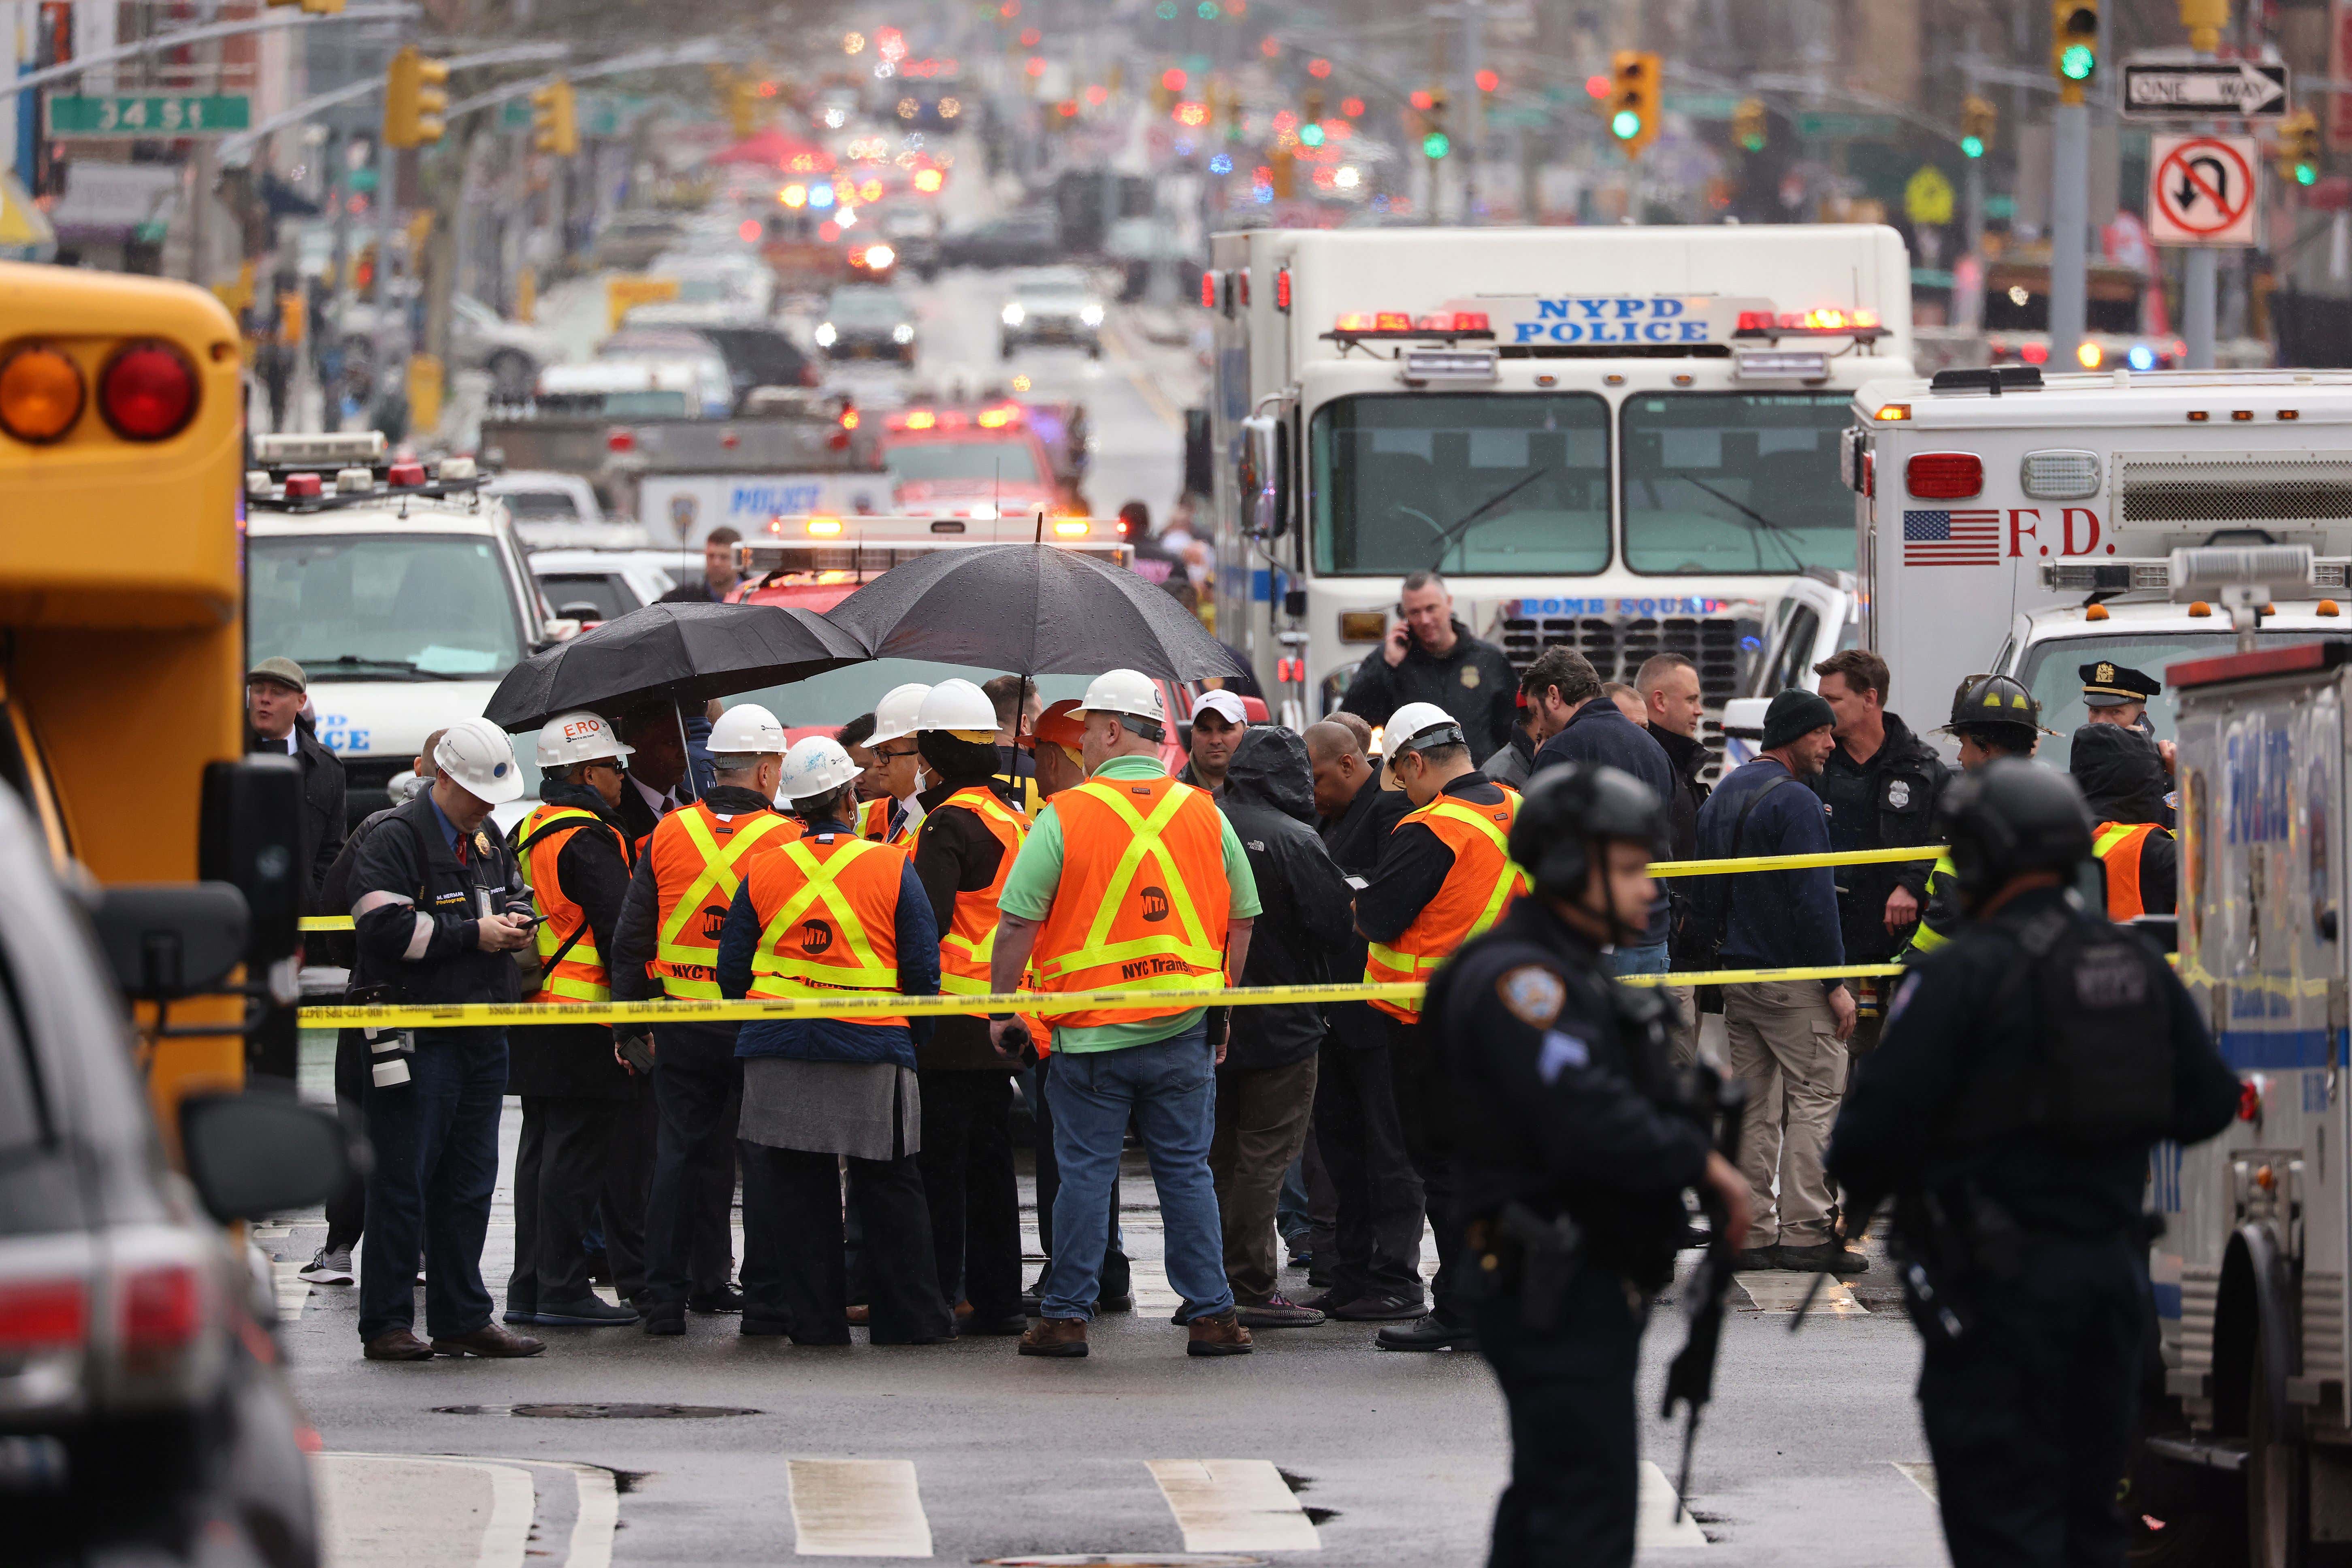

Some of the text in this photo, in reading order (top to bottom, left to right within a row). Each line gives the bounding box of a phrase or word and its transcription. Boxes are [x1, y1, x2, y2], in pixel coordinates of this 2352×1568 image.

[2137, 77, 2263, 102] ONE WAY
[1538, 298, 1684, 319] NYPD
[1515, 322, 1708, 343] POLICE
[1521, 598, 1718, 617] BOMB SQUAD
[563, 720, 600, 737] ERO
[1140, 895, 1165, 915] MTA
[801, 926, 827, 946] MTA
[671, 964, 703, 979] NYC
[1121, 960, 1149, 979] NYC
